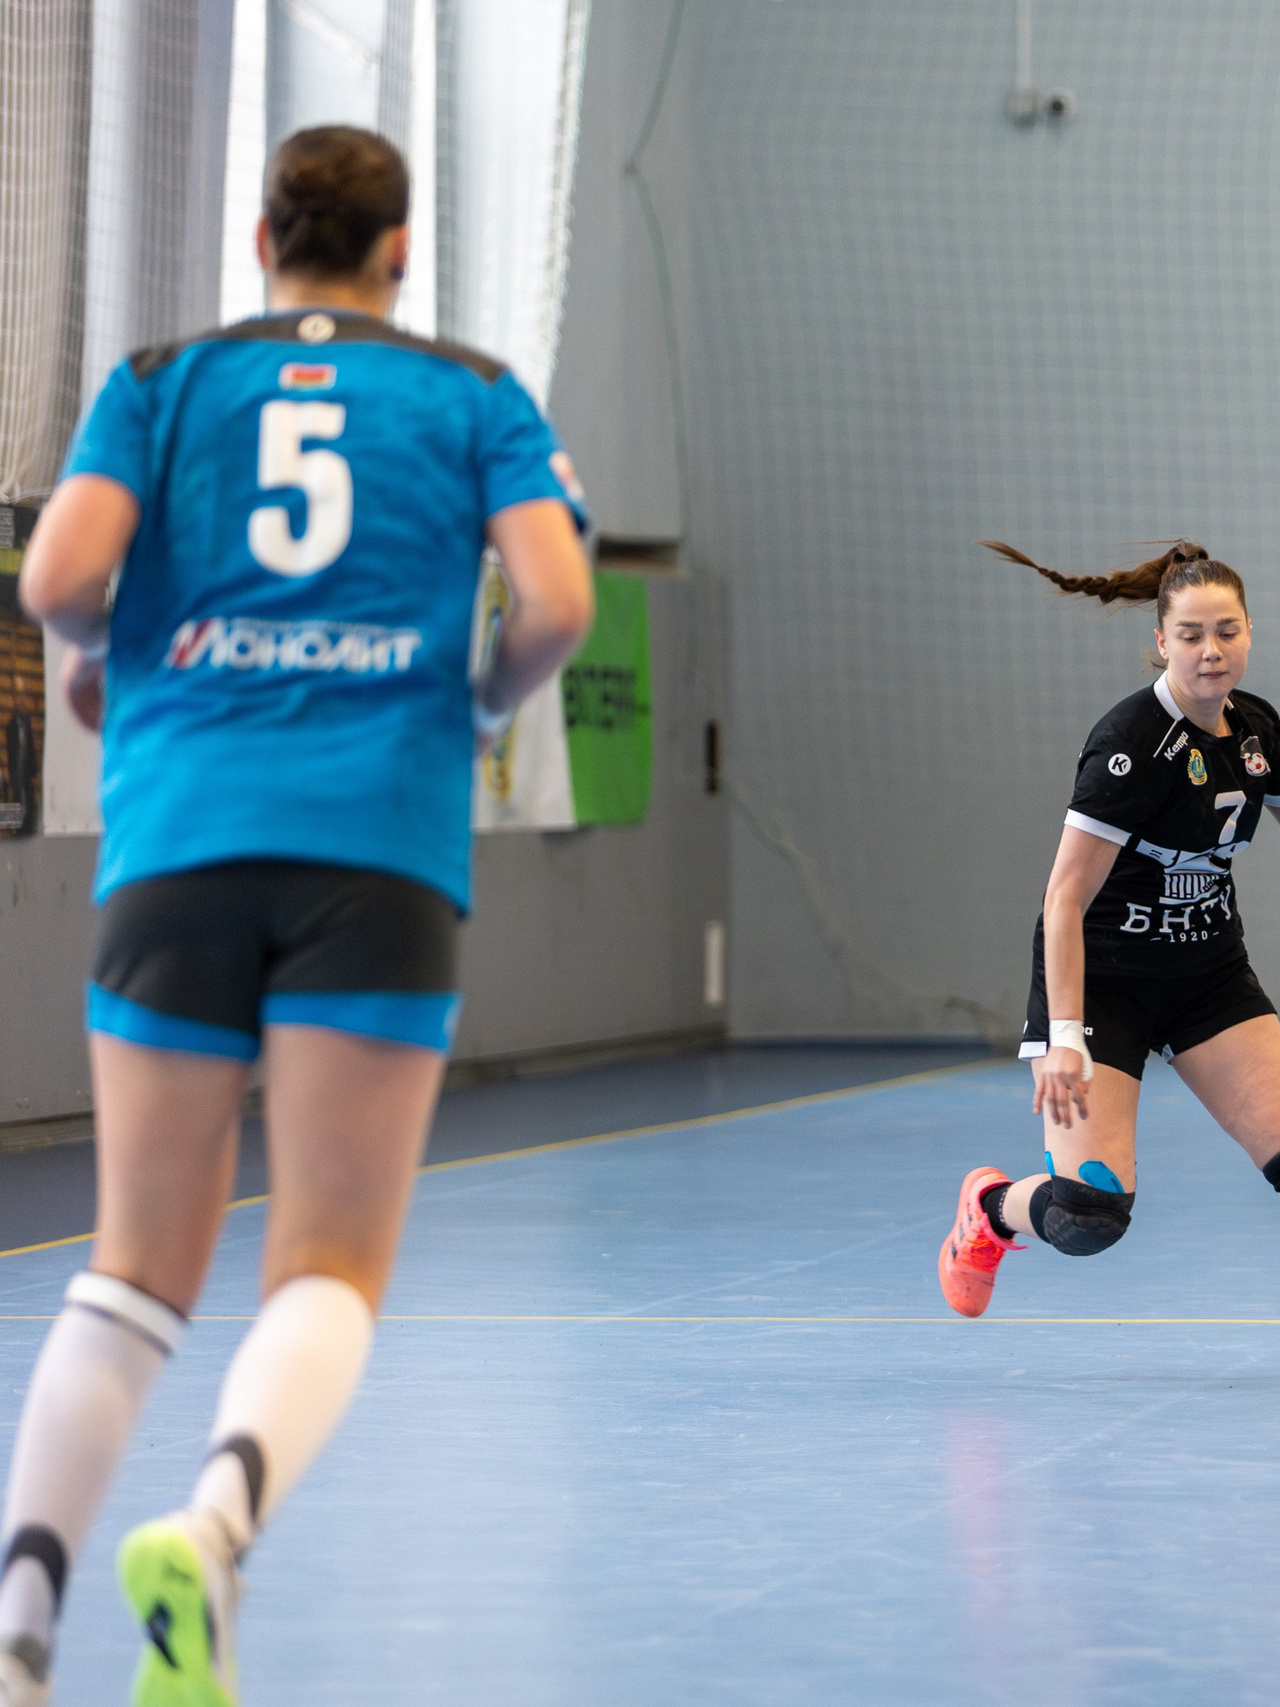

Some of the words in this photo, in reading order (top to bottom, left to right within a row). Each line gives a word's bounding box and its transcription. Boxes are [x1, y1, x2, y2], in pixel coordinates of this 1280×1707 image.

[248, 399, 353, 578] 5
[1163, 730, 1190, 761] Kempa
[1214, 790, 1247, 845] 7
[1169, 930, 1208, 943] 1920
